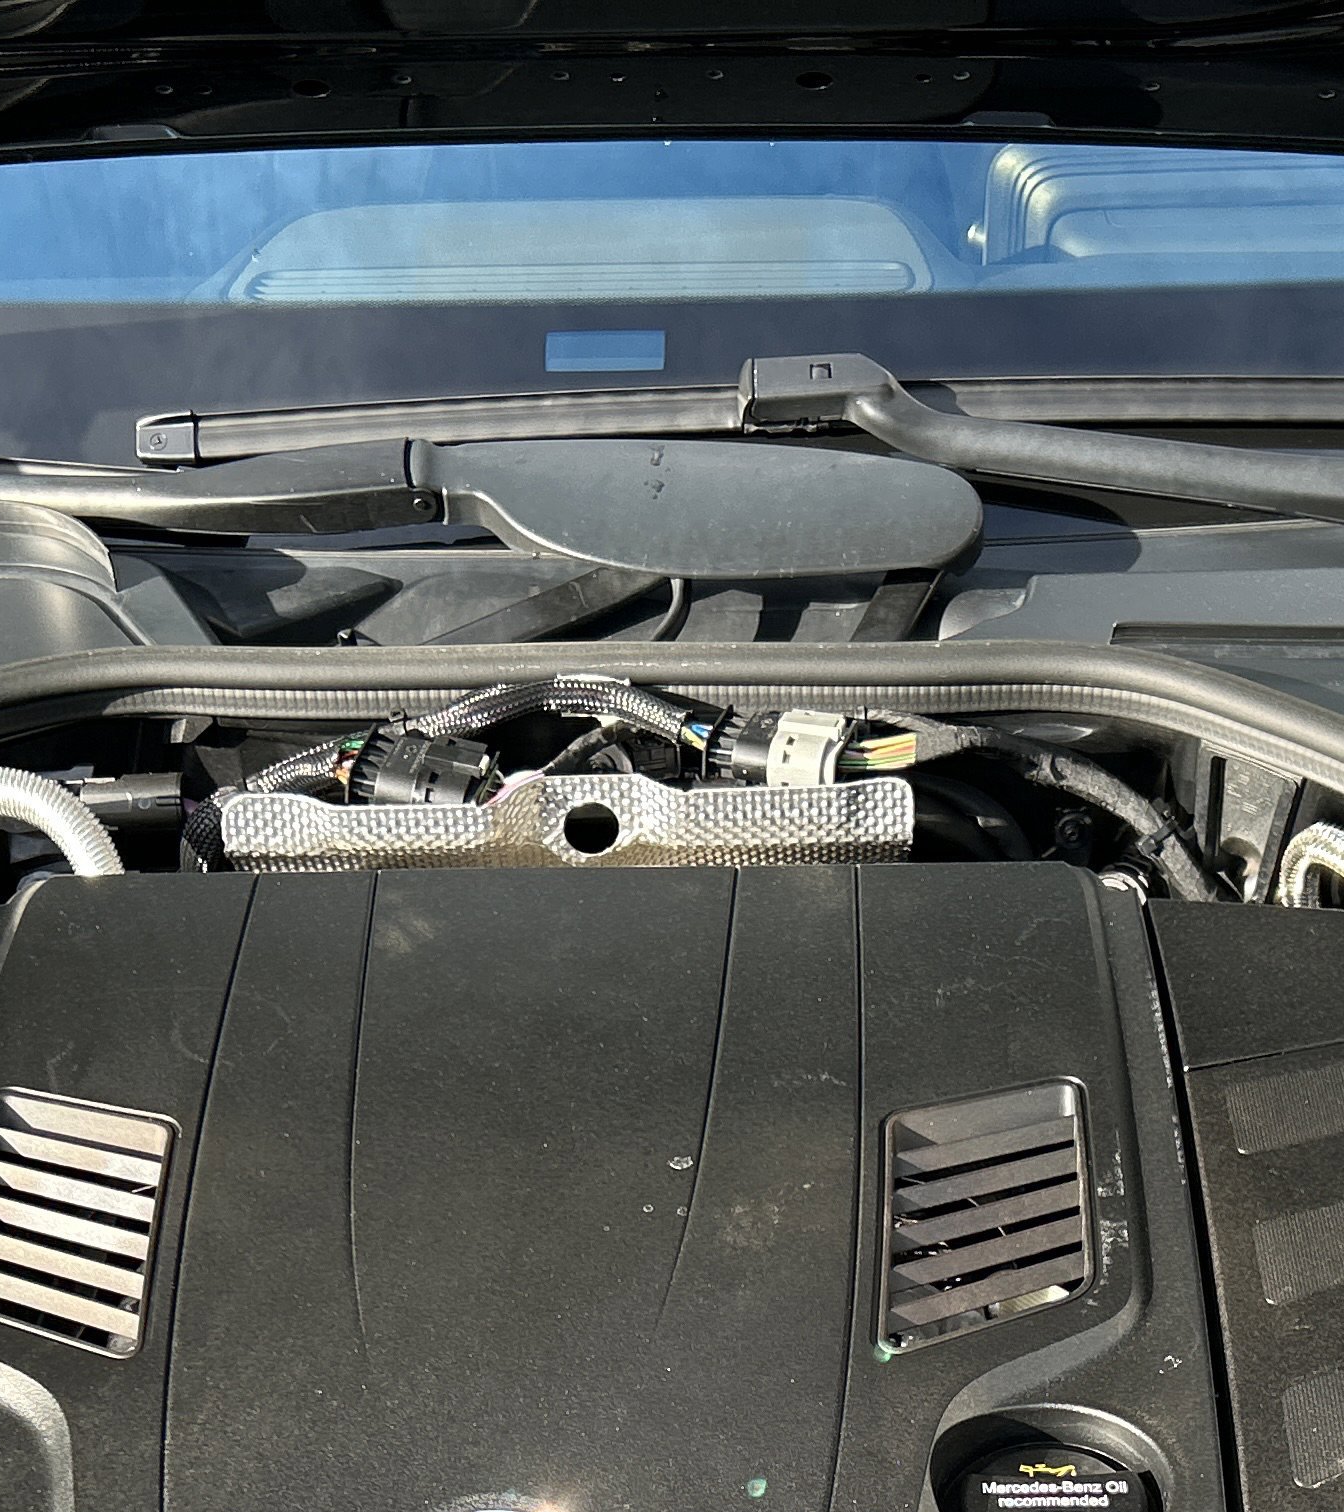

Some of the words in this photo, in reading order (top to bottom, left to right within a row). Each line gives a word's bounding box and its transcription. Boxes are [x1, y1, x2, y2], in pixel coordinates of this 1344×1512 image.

[982, 1481, 1103, 1494] Mercedes-Benz
[1105, 1480, 1128, 1494] Oil
[998, 1495, 1109, 1507] recommended
